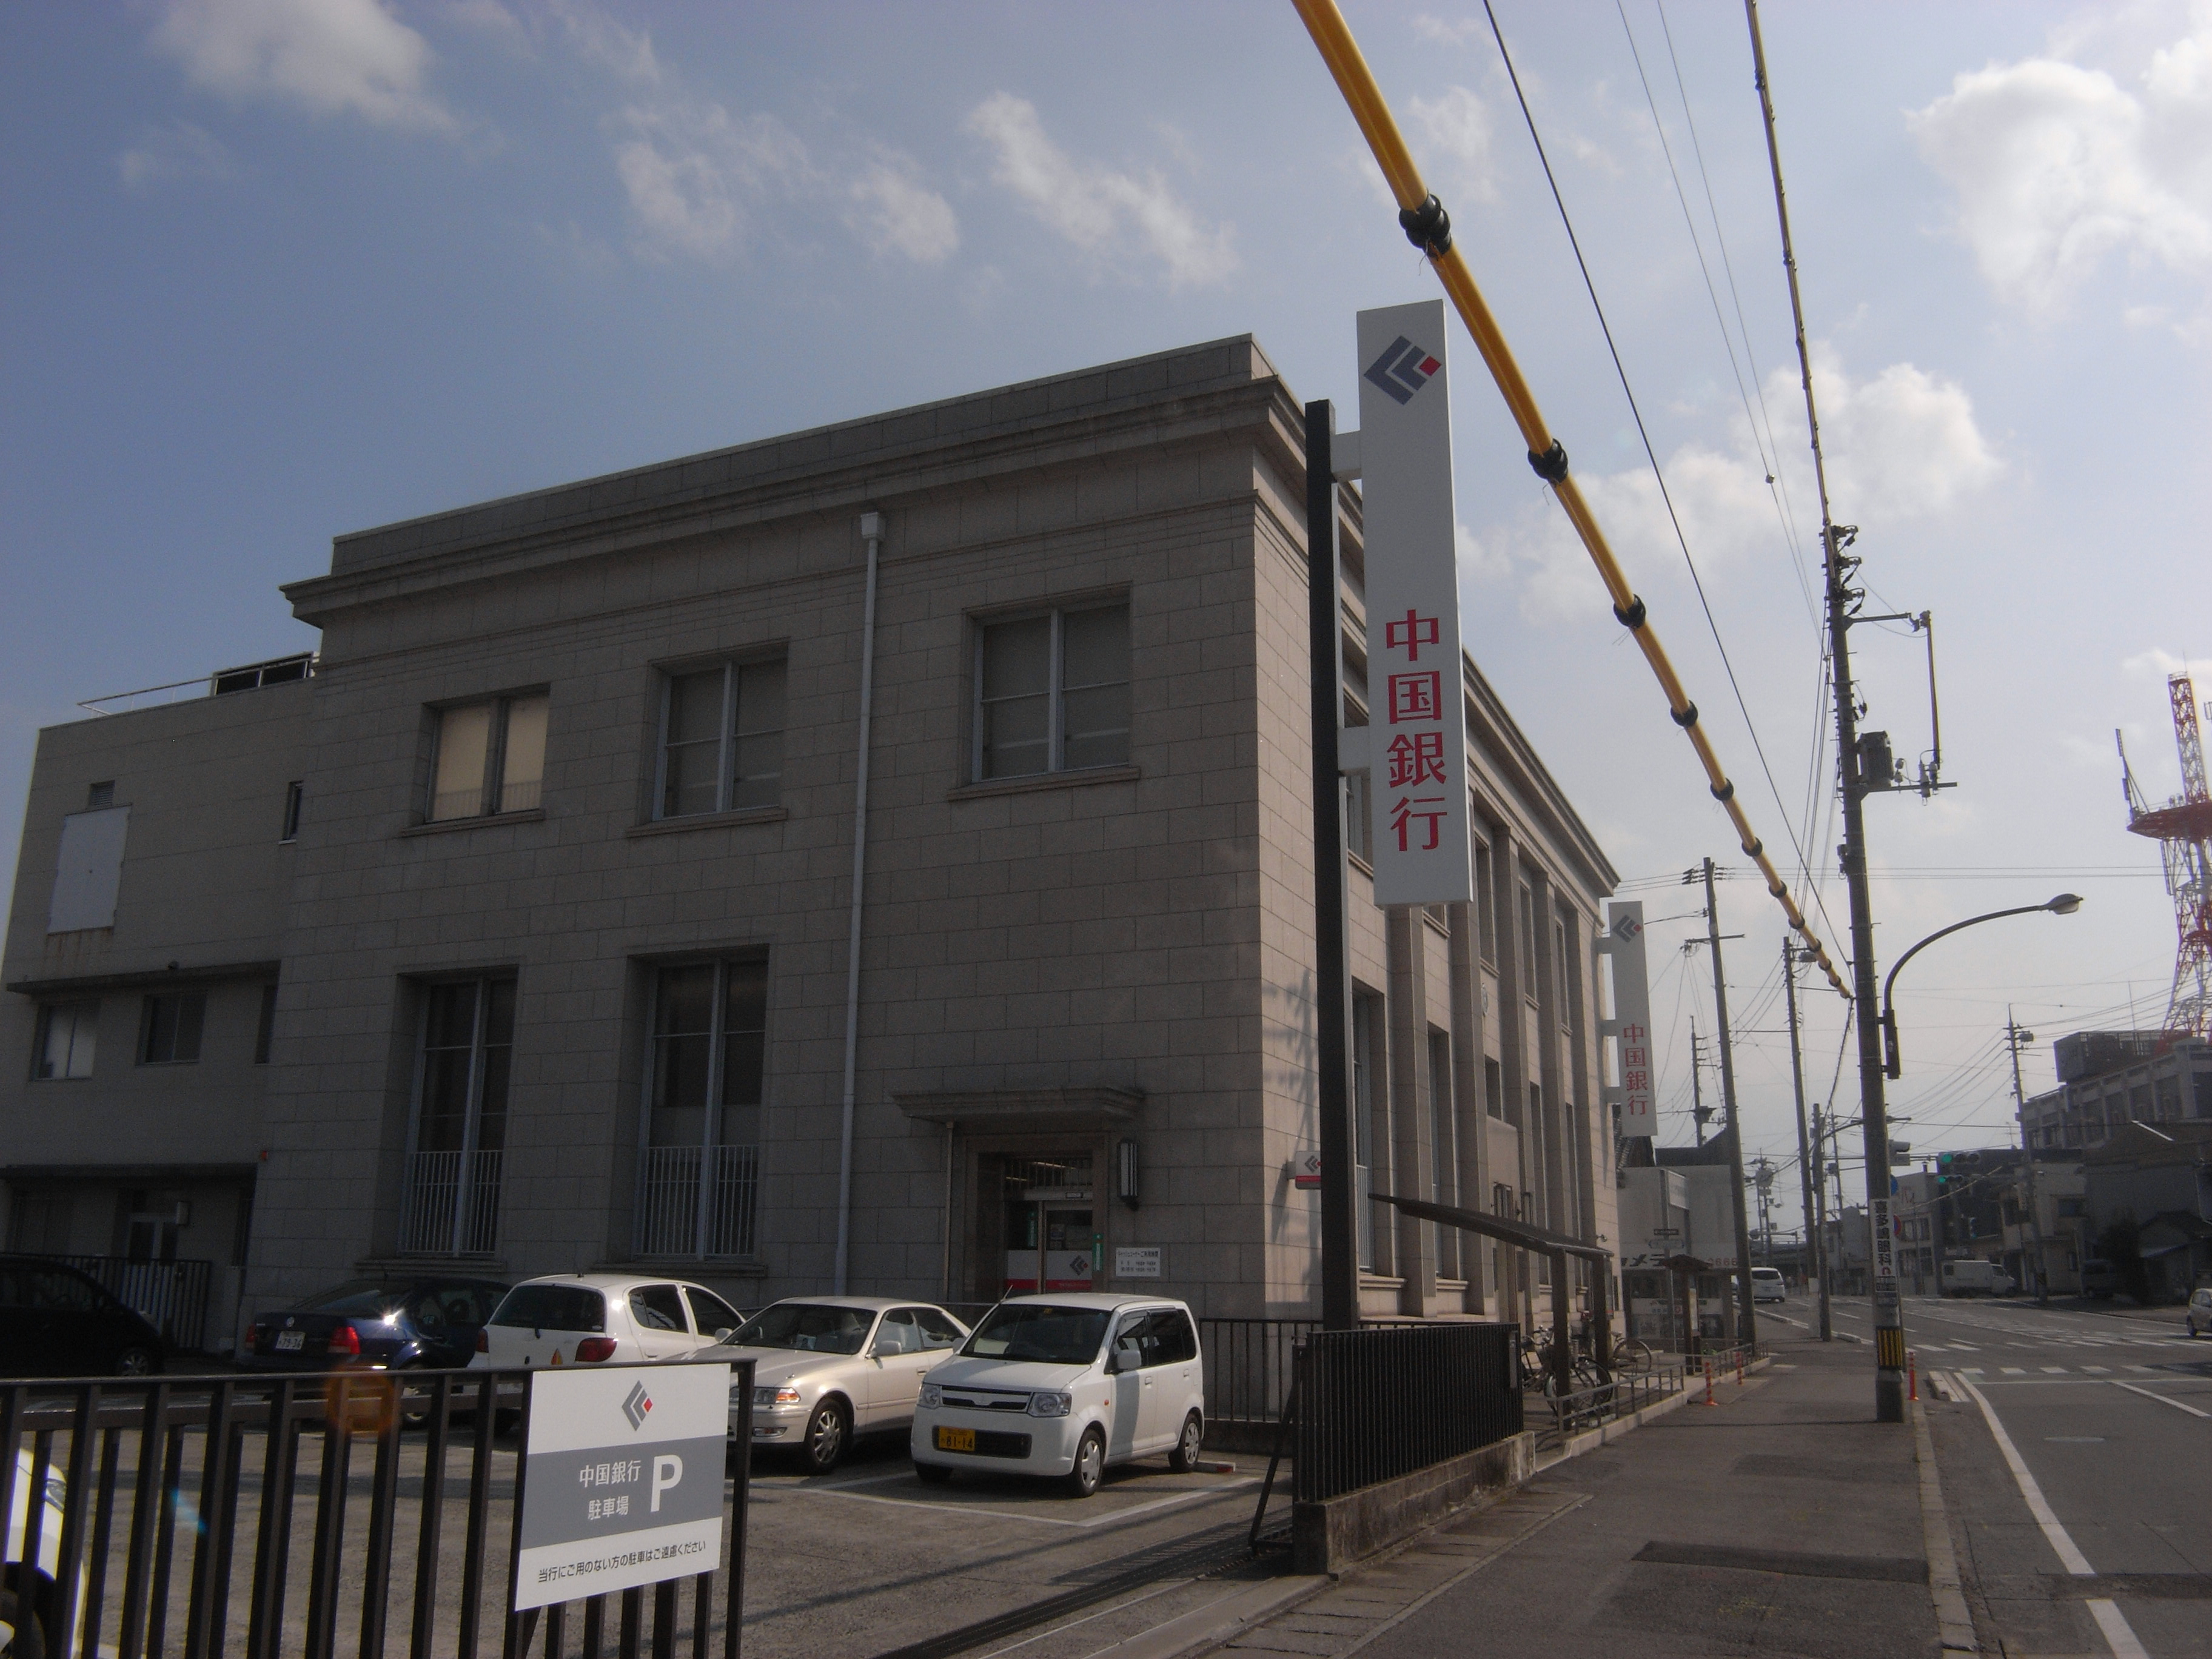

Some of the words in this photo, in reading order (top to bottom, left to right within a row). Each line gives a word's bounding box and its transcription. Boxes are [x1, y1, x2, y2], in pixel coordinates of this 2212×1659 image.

[1386, 609, 1447, 852] 中国銀行
[1623, 1023, 1647, 1115] 中国銀行
[579, 1460, 641, 1488] 中国銀行
[650, 1454, 683, 1513] P
[588, 1495, 629, 1521] 駐車場
[538, 1540, 706, 1583] 当行にご用のない方の駐車はご遠慮ください
